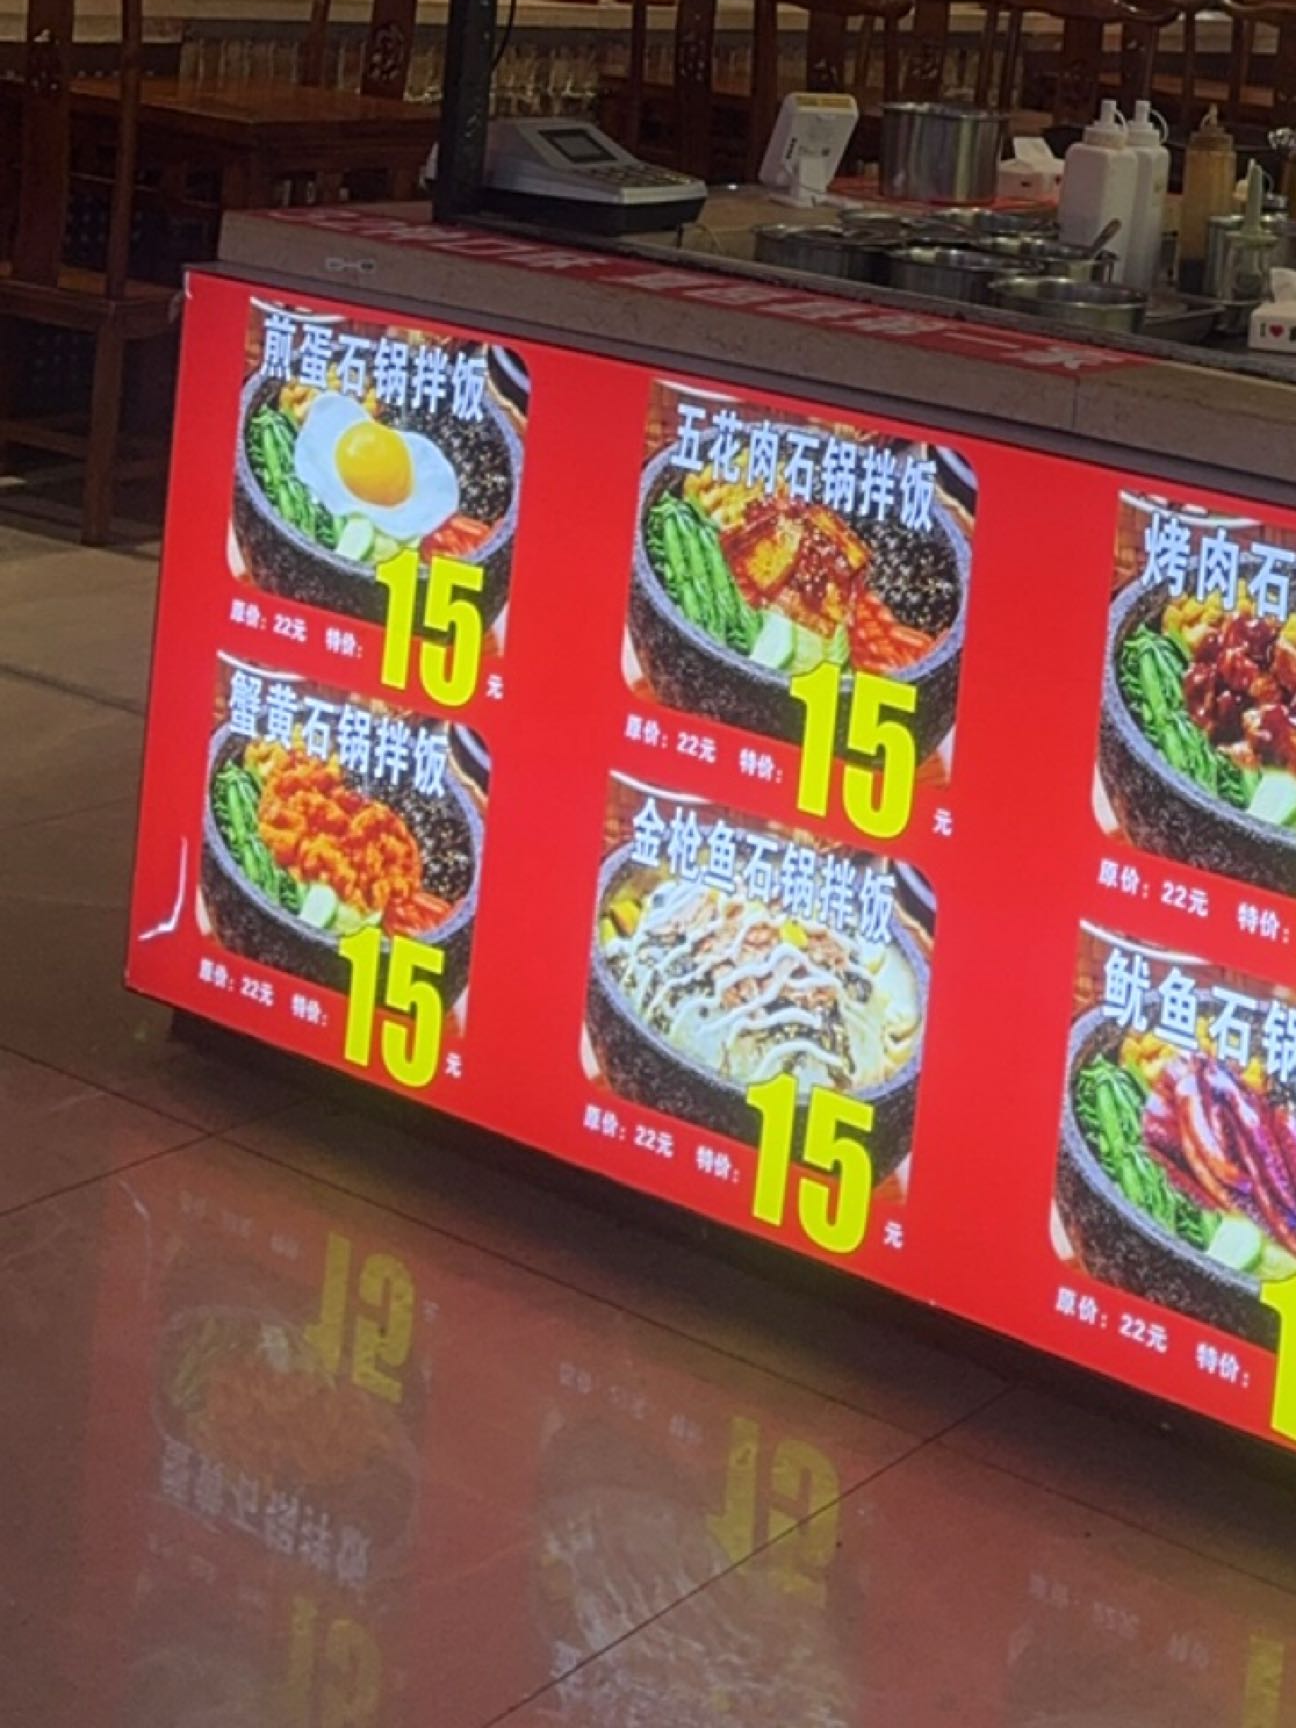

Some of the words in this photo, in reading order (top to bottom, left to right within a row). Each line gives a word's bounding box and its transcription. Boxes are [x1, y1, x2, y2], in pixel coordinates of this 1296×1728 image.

[260, 313, 489, 423] 煎蛋石锅拌饭
[670, 403, 938, 532] 五花肉石锅拌饭
[631, 797, 897, 946] 金枪鱼石锅拌饭
